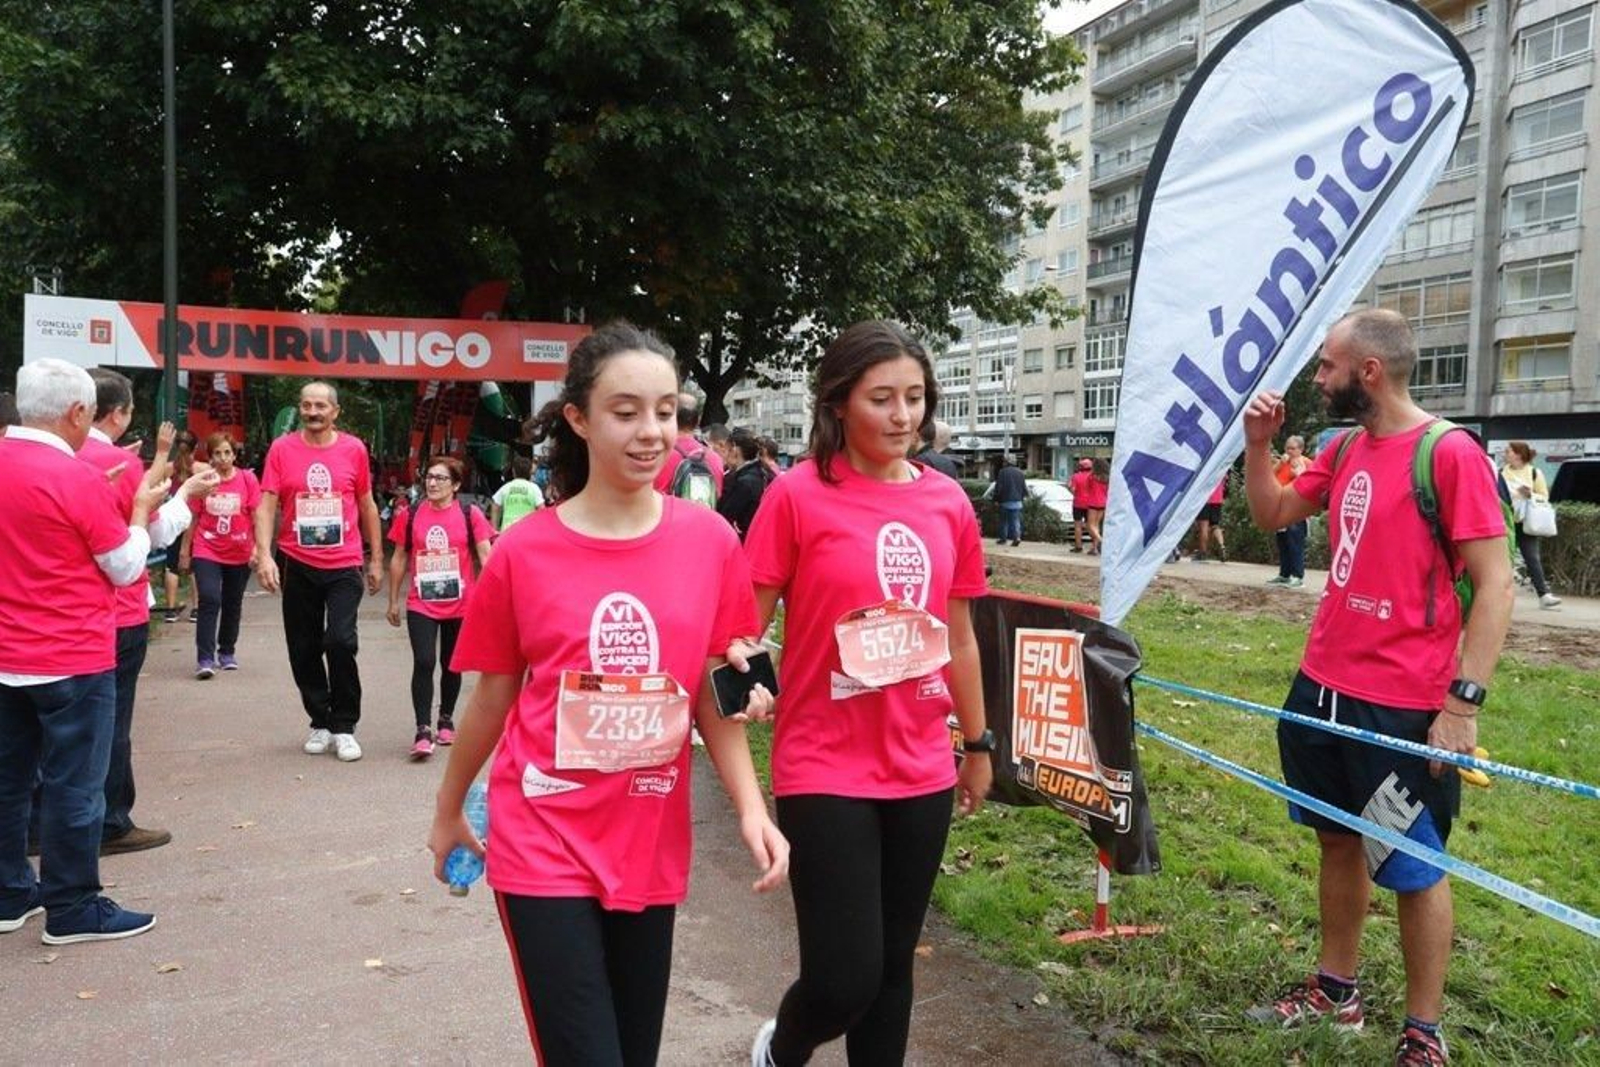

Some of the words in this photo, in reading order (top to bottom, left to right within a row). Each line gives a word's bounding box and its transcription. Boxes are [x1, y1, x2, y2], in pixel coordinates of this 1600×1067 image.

[1121, 71, 1432, 547] Atlántico
[36, 319, 84, 330] CONCELLO
[41, 328, 53, 336] DE
[57, 329, 80, 337] VIGO
[526, 343, 565, 352] CONCELLO
[543, 351, 561, 359] VIGO
[1065, 434, 1108, 446] farmacia
[888, 533, 908, 547] VI
[885, 553, 922, 566] VIGO
[608, 603, 633, 623] VI
[600, 631, 647, 646] VIGO
[860, 620, 925, 662] 5524
[599, 646, 635, 655] CONTRA
[636, 646, 650, 655] EL
[579, 674, 603, 683] RUN
[1020, 680, 1072, 719] THE
[586, 703, 664, 742] 2334
[1474, 757, 1576, 793] DECATHLON
